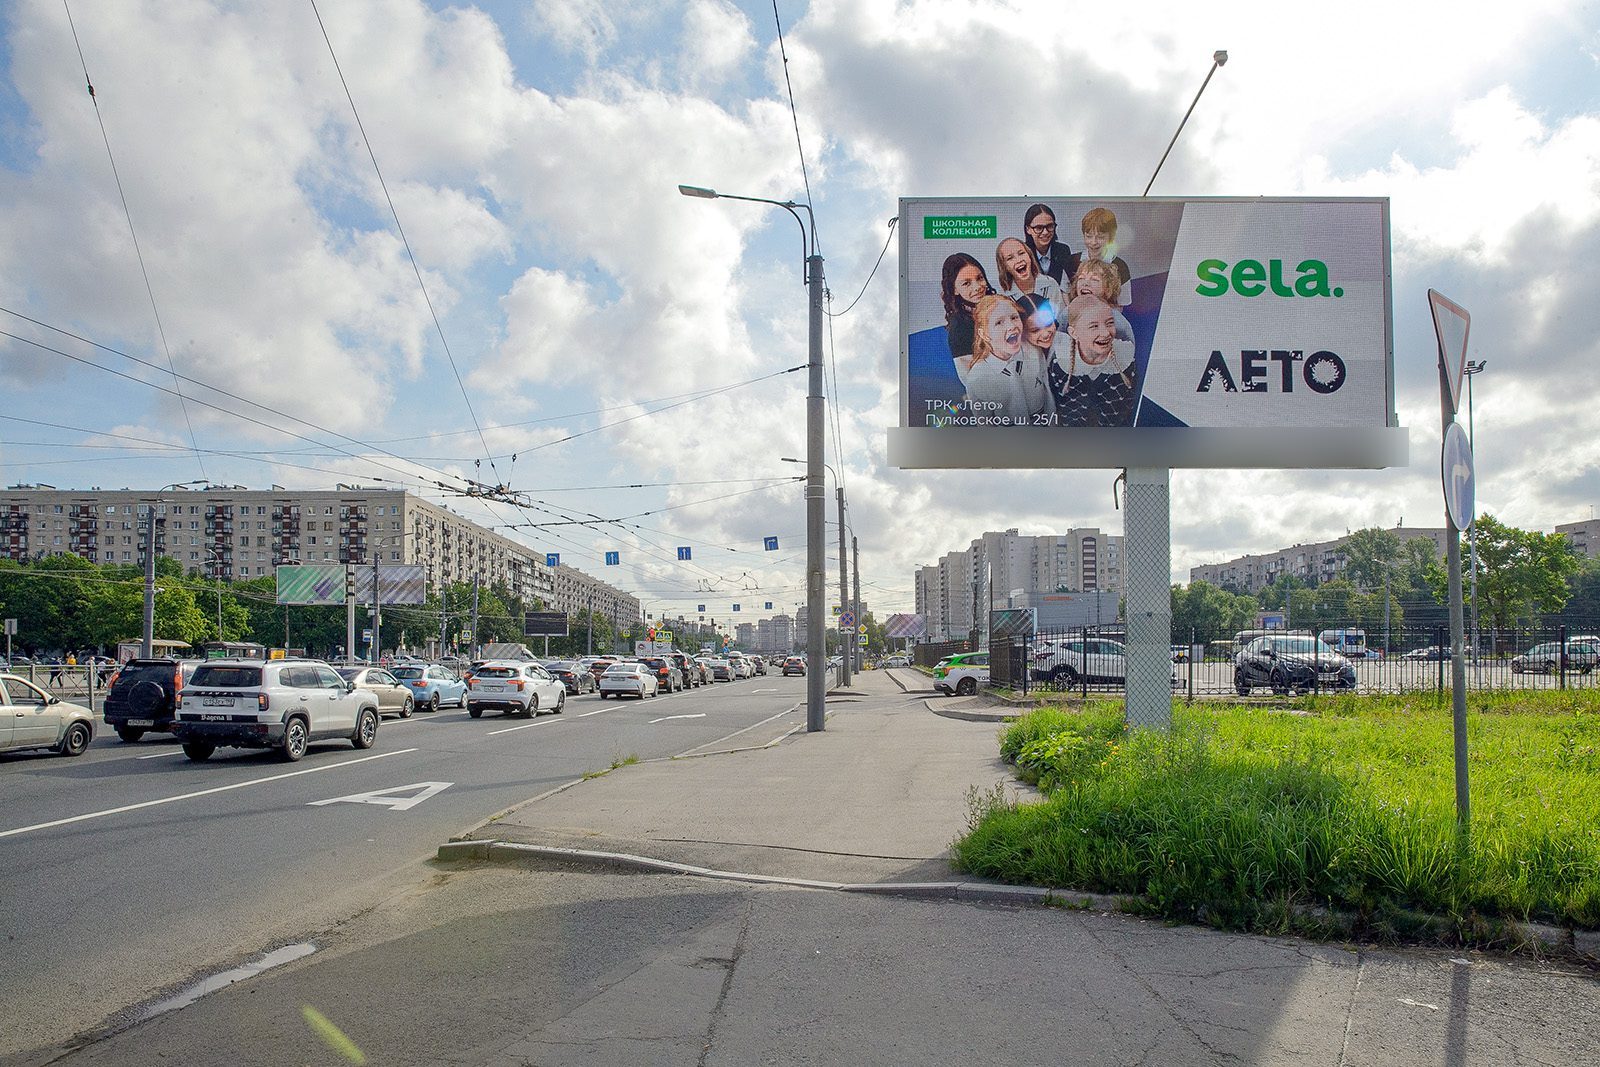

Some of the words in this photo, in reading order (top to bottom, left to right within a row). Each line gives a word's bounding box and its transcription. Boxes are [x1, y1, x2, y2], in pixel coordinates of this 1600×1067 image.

[932, 228, 991, 236] КОЛЛЕКЦИЯ
[1195, 259, 1344, 298] sela.
[1196, 350, 1346, 394] ЛЕТО
[925, 399, 952, 411] ТРК
[956, 399, 1003, 411] «Лето»
[925, 413, 1011, 427] Пулковское
[1014, 417, 1029, 426] ш.
[1032, 413, 1058, 426] 25/1
